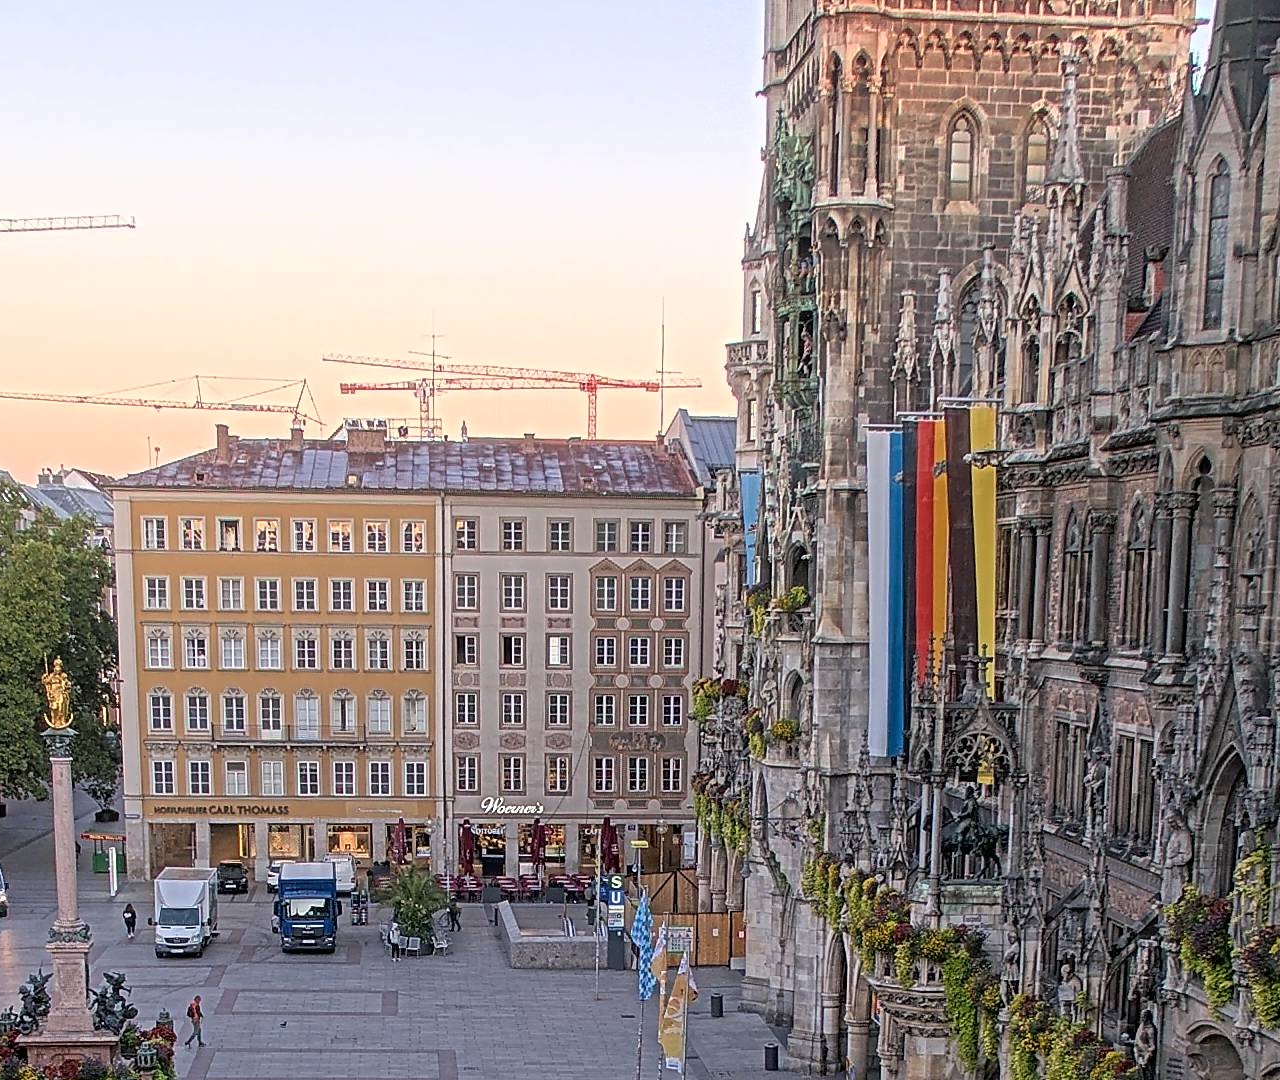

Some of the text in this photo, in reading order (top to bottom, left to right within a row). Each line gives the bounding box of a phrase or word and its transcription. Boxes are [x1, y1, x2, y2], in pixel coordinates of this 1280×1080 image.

[208, 805, 235, 815] CARL
[237, 805, 289, 816] THOMASS
[480, 797, 544, 814] Woerner's
[611, 876, 622, 889] S
[611, 891, 621, 904] U
